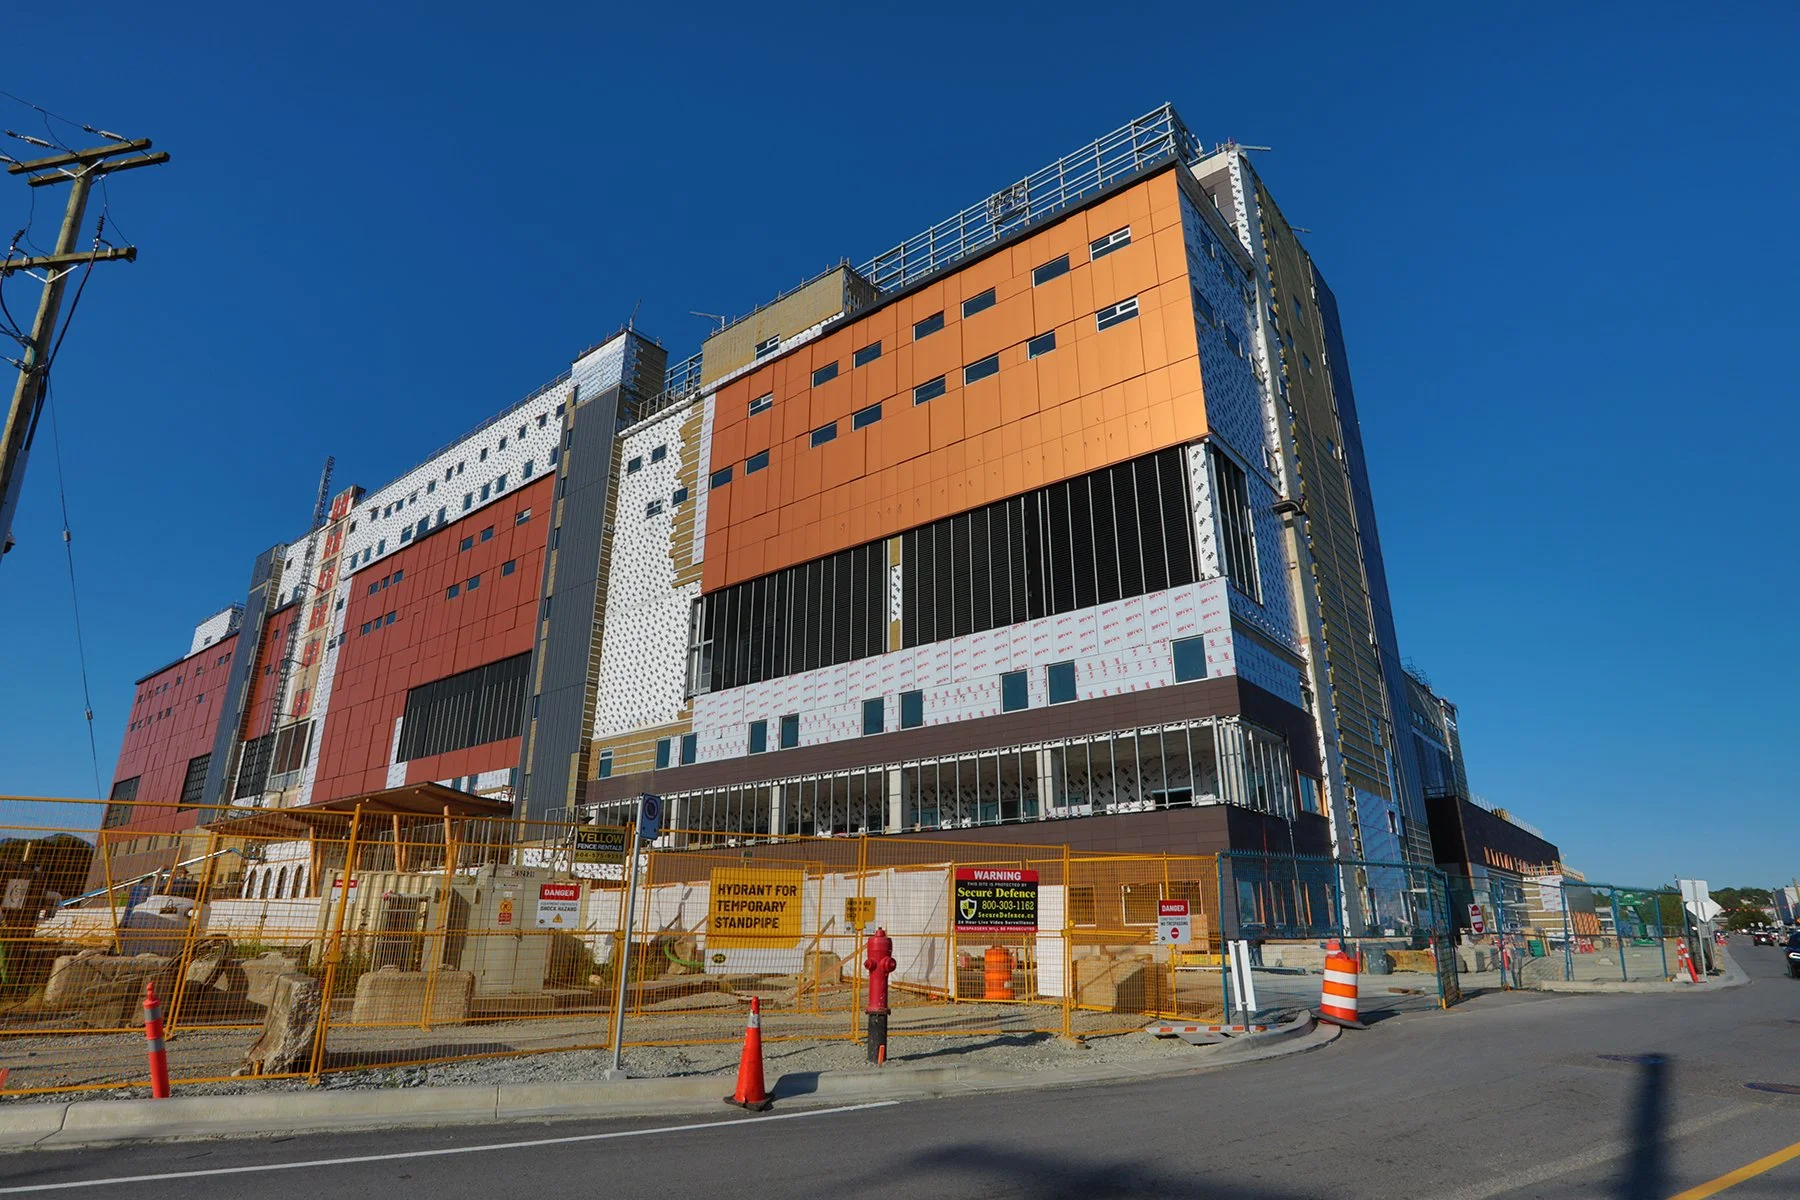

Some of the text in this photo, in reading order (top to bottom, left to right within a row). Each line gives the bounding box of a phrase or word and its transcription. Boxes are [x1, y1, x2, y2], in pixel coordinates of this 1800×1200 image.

[579, 832, 623, 844] YELLOW
[577, 842, 623, 851] FENCE RENTALS
[974, 870, 1021, 880] WARNING
[544, 889, 575, 897] DANGER
[717, 884, 797, 897] HYDRANT FOR
[957, 887, 1036, 899] Secure Defence
[716, 900, 786, 913] TEMPORARY
[981, 900, 1035, 911] 800-303-1162
[978, 911, 1034, 919] SecureDefence.ca
[714, 916, 780, 929] STANDPIPE
